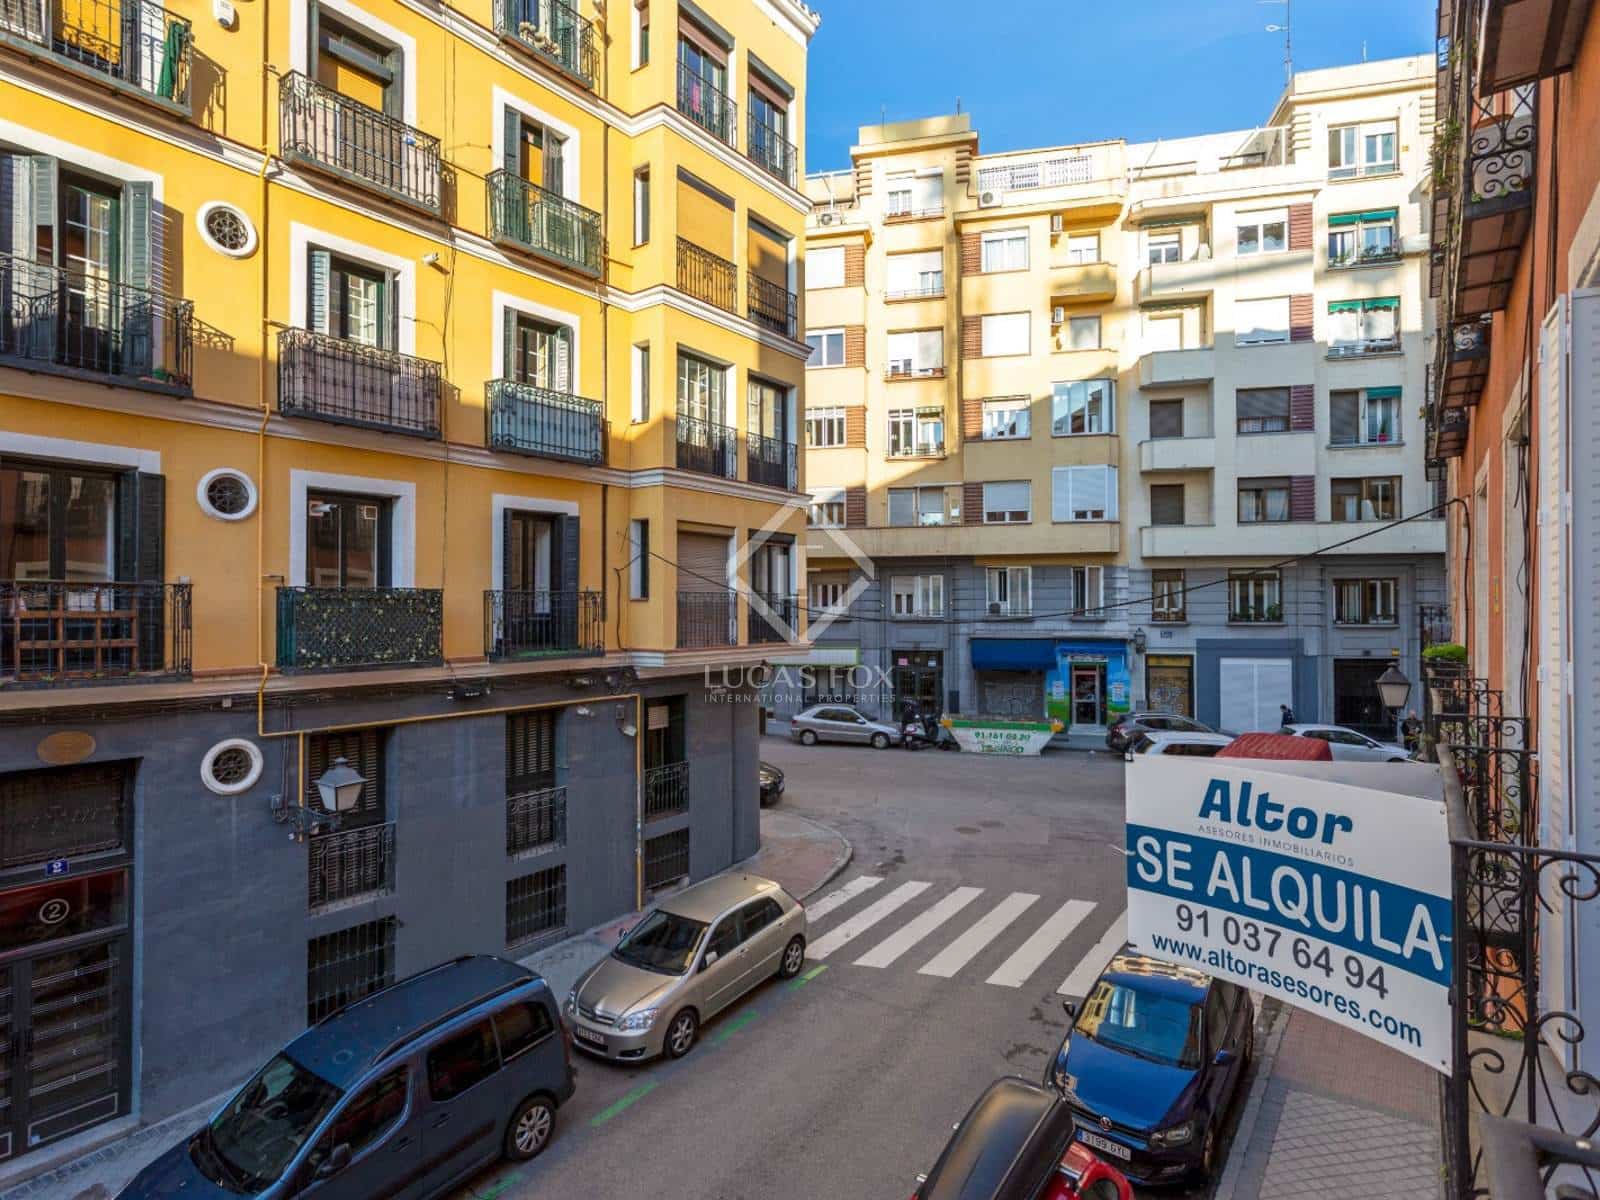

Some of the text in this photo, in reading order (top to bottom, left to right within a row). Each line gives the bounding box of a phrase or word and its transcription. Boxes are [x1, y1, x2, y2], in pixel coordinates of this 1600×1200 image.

[1198, 824, 1355, 868] ASESORES INMOBILIARIOS
[1199, 778, 1353, 845] Altor
[47, 903, 61, 919] 2
[1136, 835, 1444, 971] SE ALQUILA
[1152, 933, 1423, 1048] www.altorasesores.com
[1176, 903, 1390, 1000] 91 037 64 94
